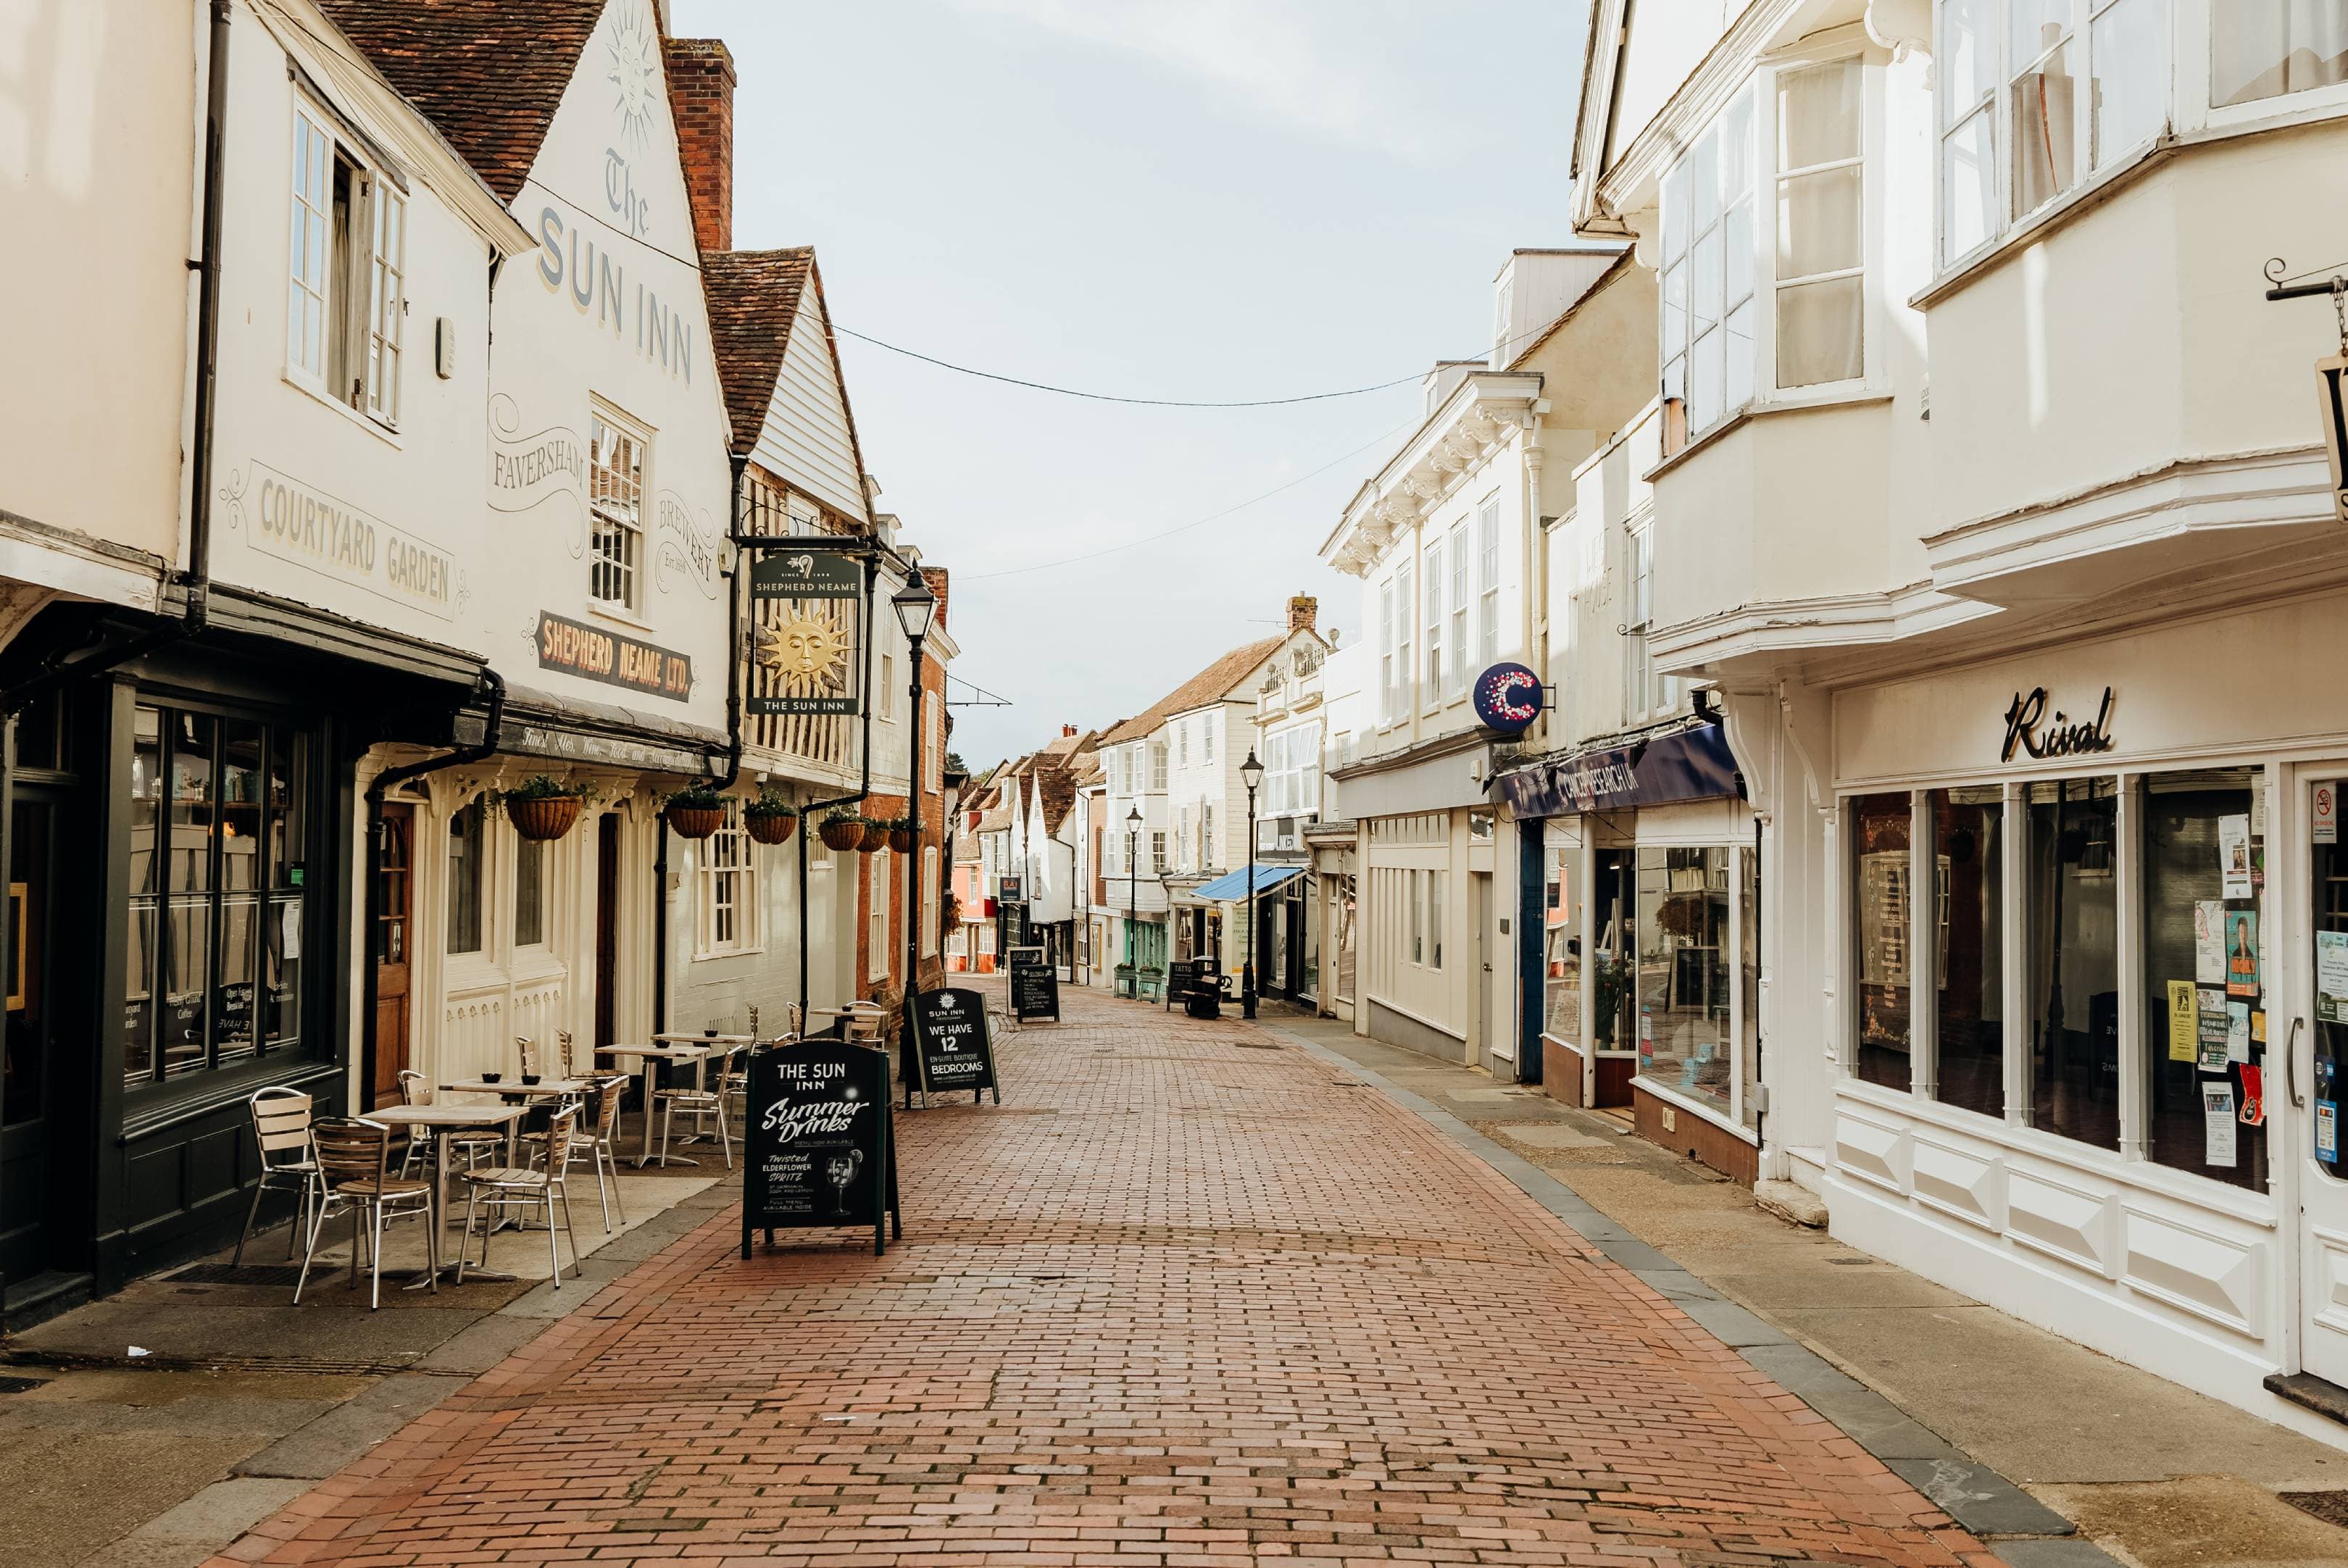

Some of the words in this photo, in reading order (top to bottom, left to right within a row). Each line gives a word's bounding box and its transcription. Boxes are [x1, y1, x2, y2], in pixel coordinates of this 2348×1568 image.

[606, 147, 649, 237] The
[536, 207, 623, 338] SUN
[636, 282, 691, 387] INN
[494, 441, 584, 491] FAVERSHAM
[260, 479, 375, 573] COURTYARD
[388, 536, 449, 603] GARDEN
[659, 500, 712, 582] BREWERY
[756, 583, 815, 591] SHEPHERD
[819, 583, 856, 591] NEAME
[544, 620, 613, 675] SHEPHERD
[619, 641, 662, 687] NEAME
[666, 656, 688, 693] LTD.
[765, 701, 787, 710] THE
[793, 701, 817, 710] SUN
[823, 701, 845, 710] INN
[2001, 686, 2111, 763] Rival
[523, 727, 549, 748] Finest
[609, 741, 626, 759] Food
[632, 748, 644, 762] and
[1562, 771, 1591, 799] CANCER
[1589, 764, 1625, 795] RESEARCH
[1624, 762, 1639, 791] UK
[929, 1025, 946, 1036] WE
[948, 1024, 973, 1035] HAVE
[941, 1036, 959, 1052] 12
[778, 1064, 807, 1079] THE
[812, 1063, 846, 1078] SUN
[931, 1062, 983, 1075] BEDROOMS
[954, 1053, 978, 1062] BOUTIQUE
[796, 1080, 825, 1091] INN
[762, 1097, 870, 1130] Summer
[778, 1114, 852, 1143] Drinks
[768, 1153, 809, 1163] Twisted
[768, 1172, 803, 1182] SPRITZ
